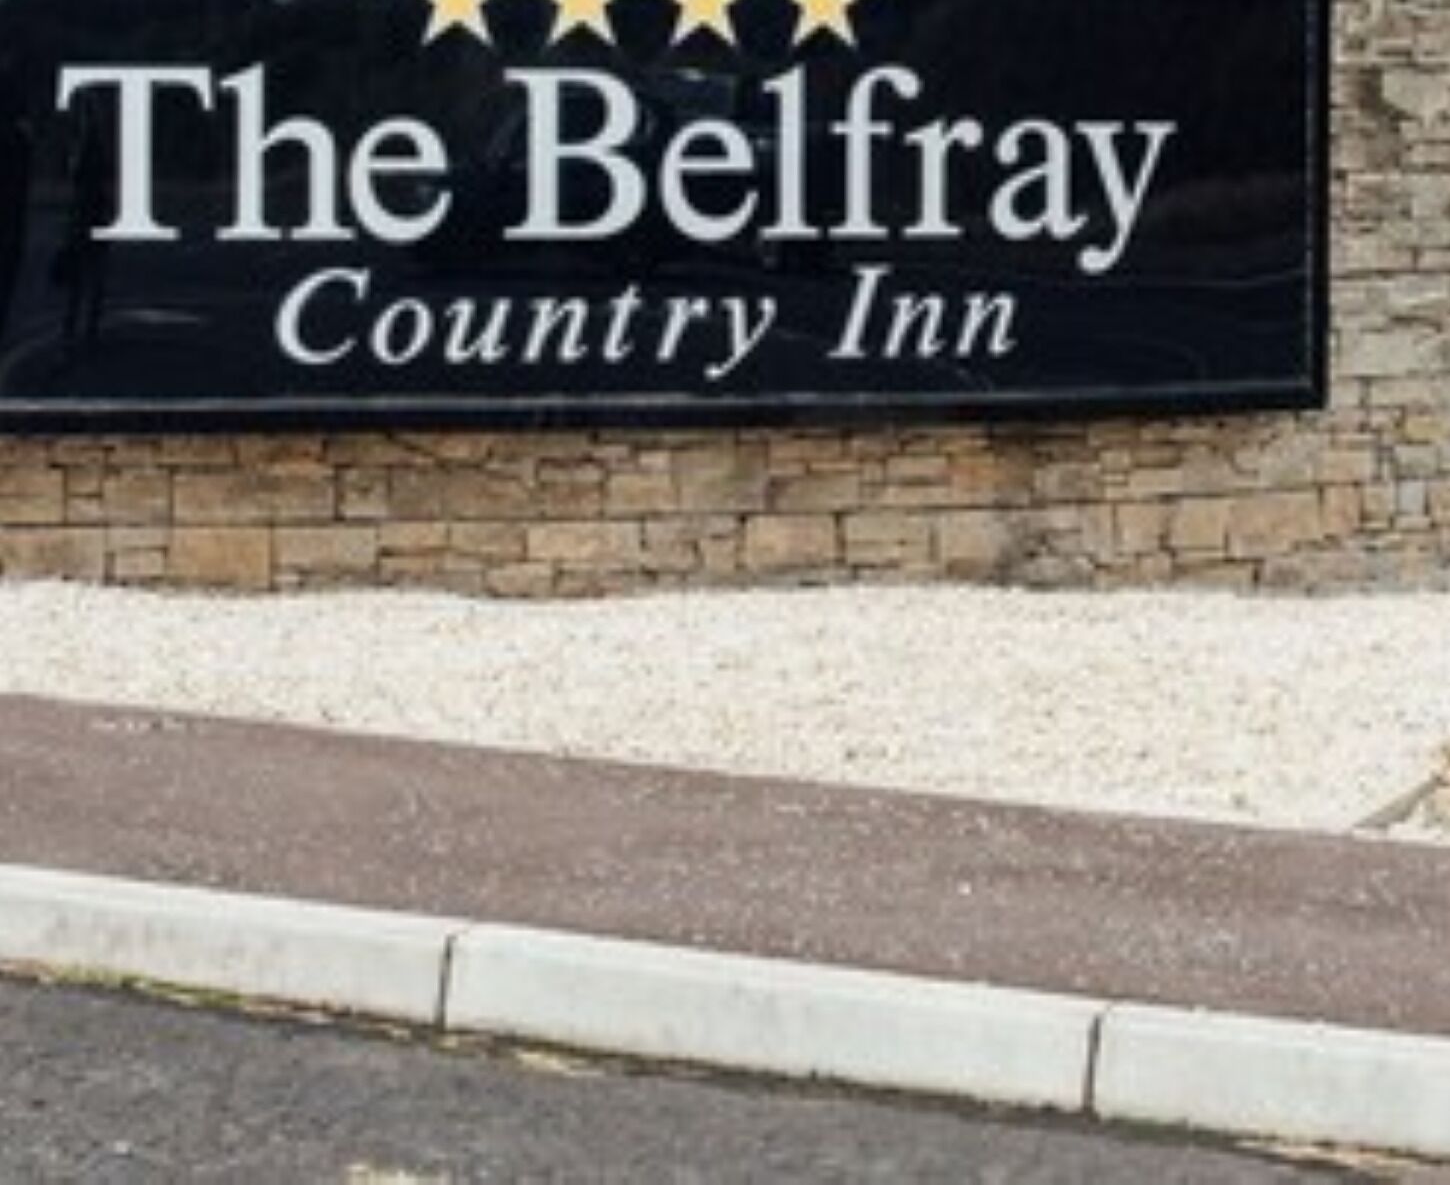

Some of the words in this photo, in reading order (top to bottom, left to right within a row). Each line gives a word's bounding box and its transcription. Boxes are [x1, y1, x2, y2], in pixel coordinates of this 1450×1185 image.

[57, 65, 454, 241] The
[505, 65, 1178, 273] Belfray
[275, 268, 777, 379] Country
[828, 266, 1018, 359] Inn
